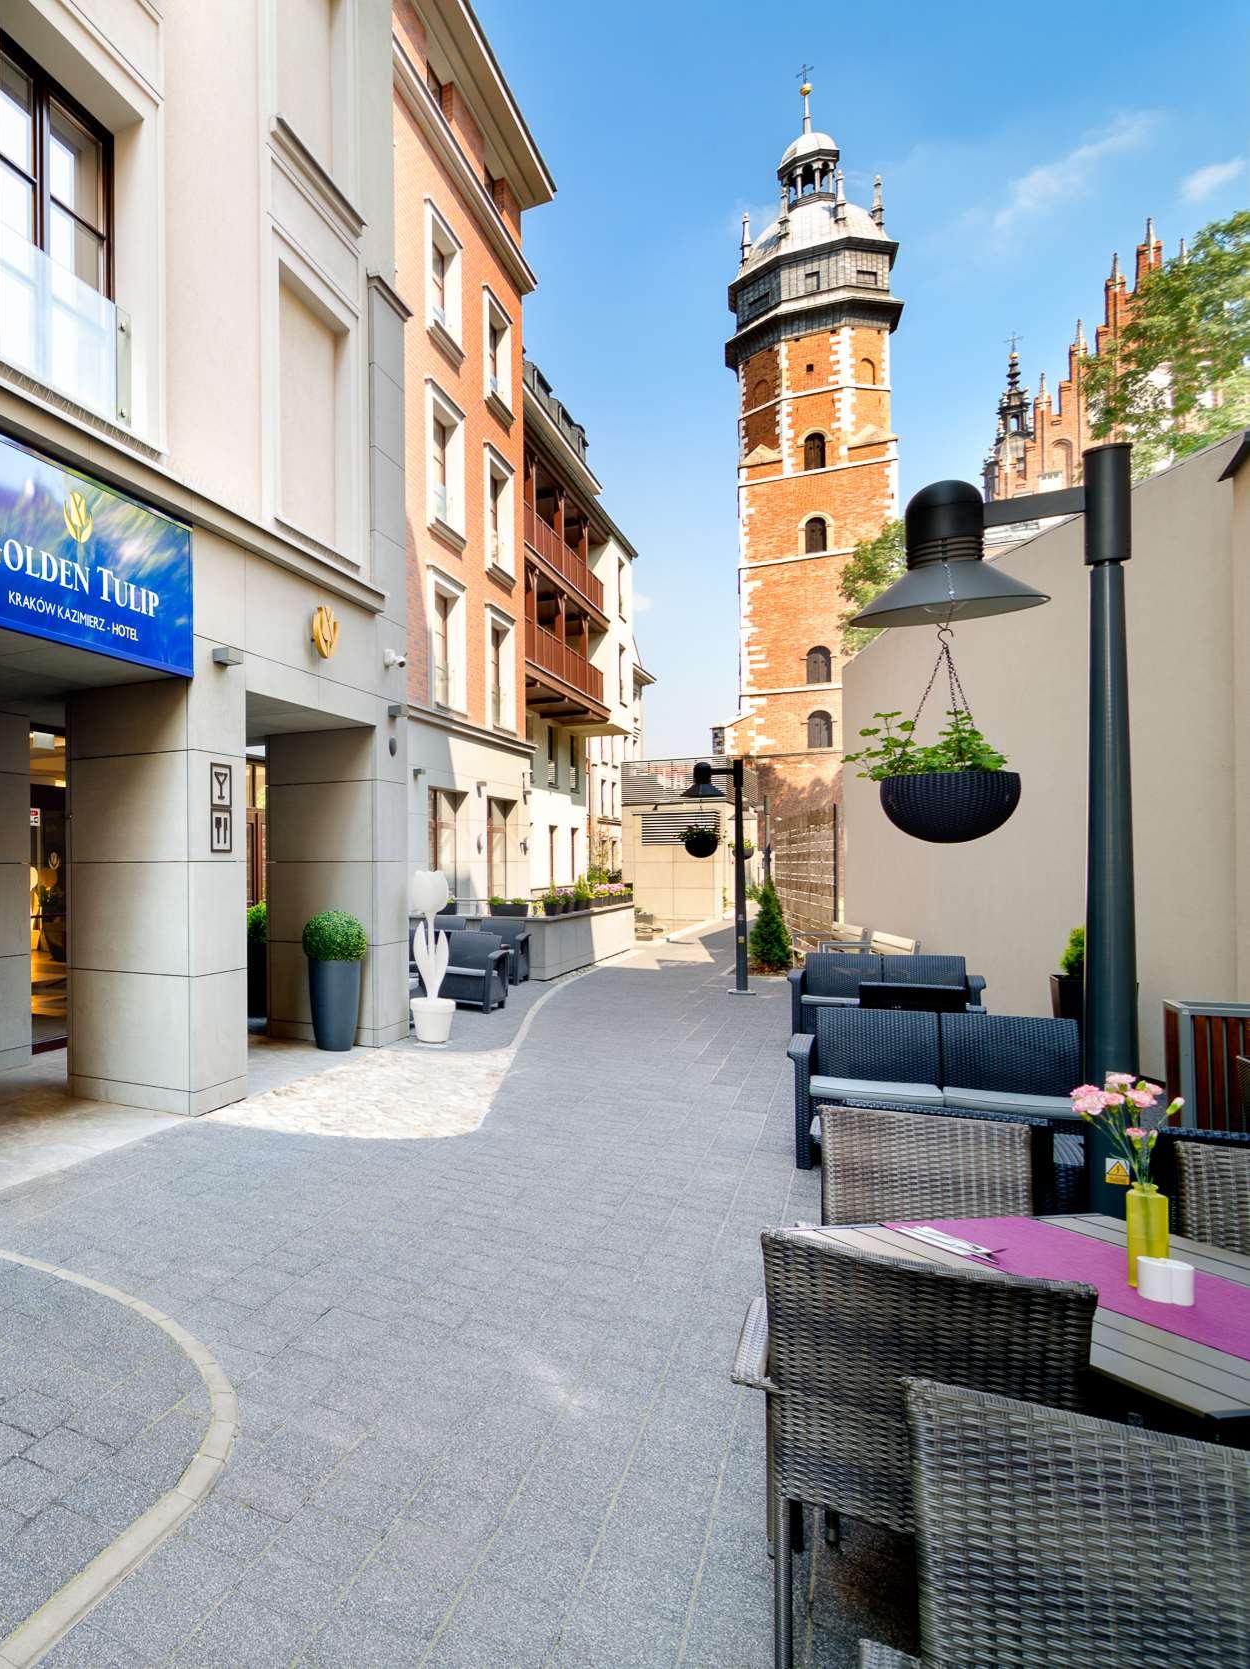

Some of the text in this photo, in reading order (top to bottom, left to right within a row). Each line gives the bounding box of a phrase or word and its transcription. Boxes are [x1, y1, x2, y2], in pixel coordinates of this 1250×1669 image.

[8, 590, 56, 616] KRAKÓW
[57, 605, 105, 632] KAZIMIERZ
[111, 622, 138, 641] HOTEL
[96, 566, 159, 617] TULIP
